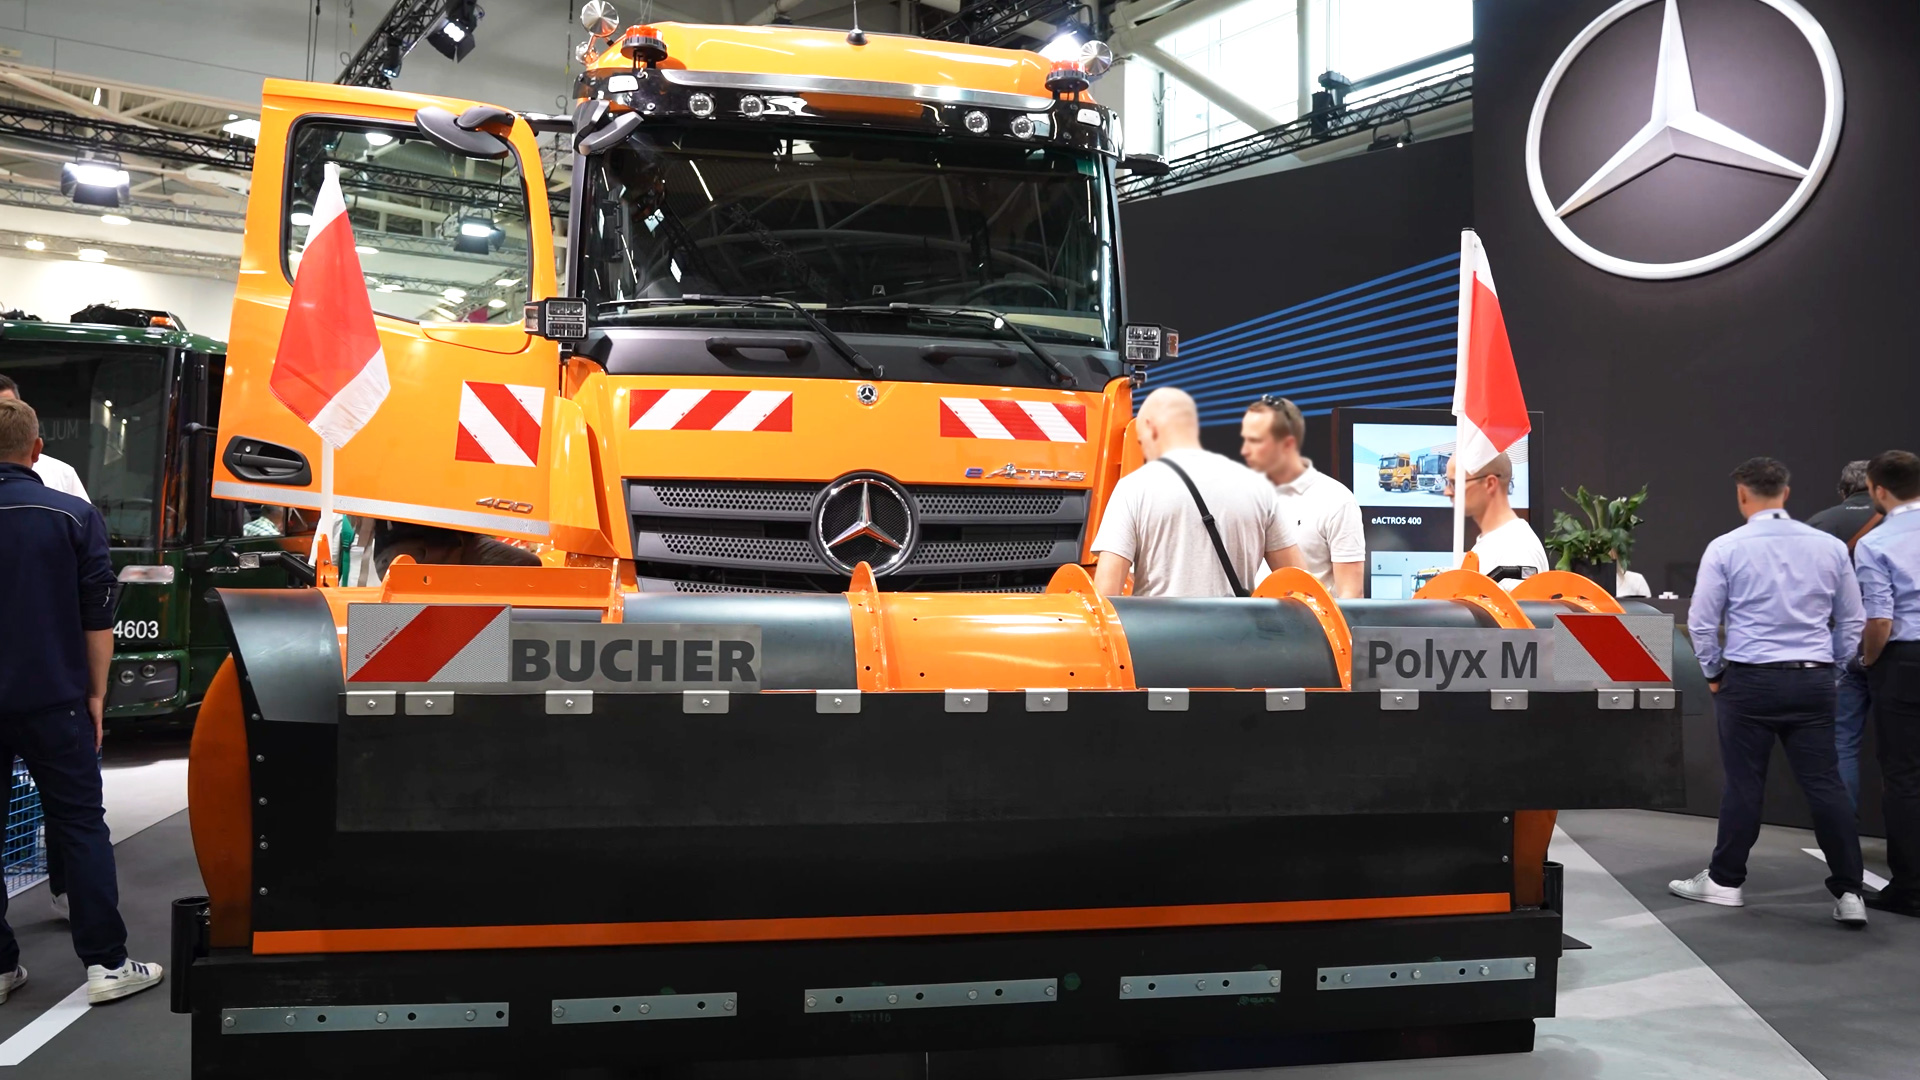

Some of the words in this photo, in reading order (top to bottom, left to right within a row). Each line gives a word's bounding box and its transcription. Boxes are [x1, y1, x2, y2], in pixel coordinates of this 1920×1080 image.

[476, 497, 533, 514] 400
[1371, 516, 1406, 525] eACTROS
[1407, 516, 1422, 525] 400
[112, 620, 159, 639] 4603
[511, 639, 757, 682] BUCHER
[1368, 639, 1487, 690] Polyx
[1501, 641, 1538, 679] M
